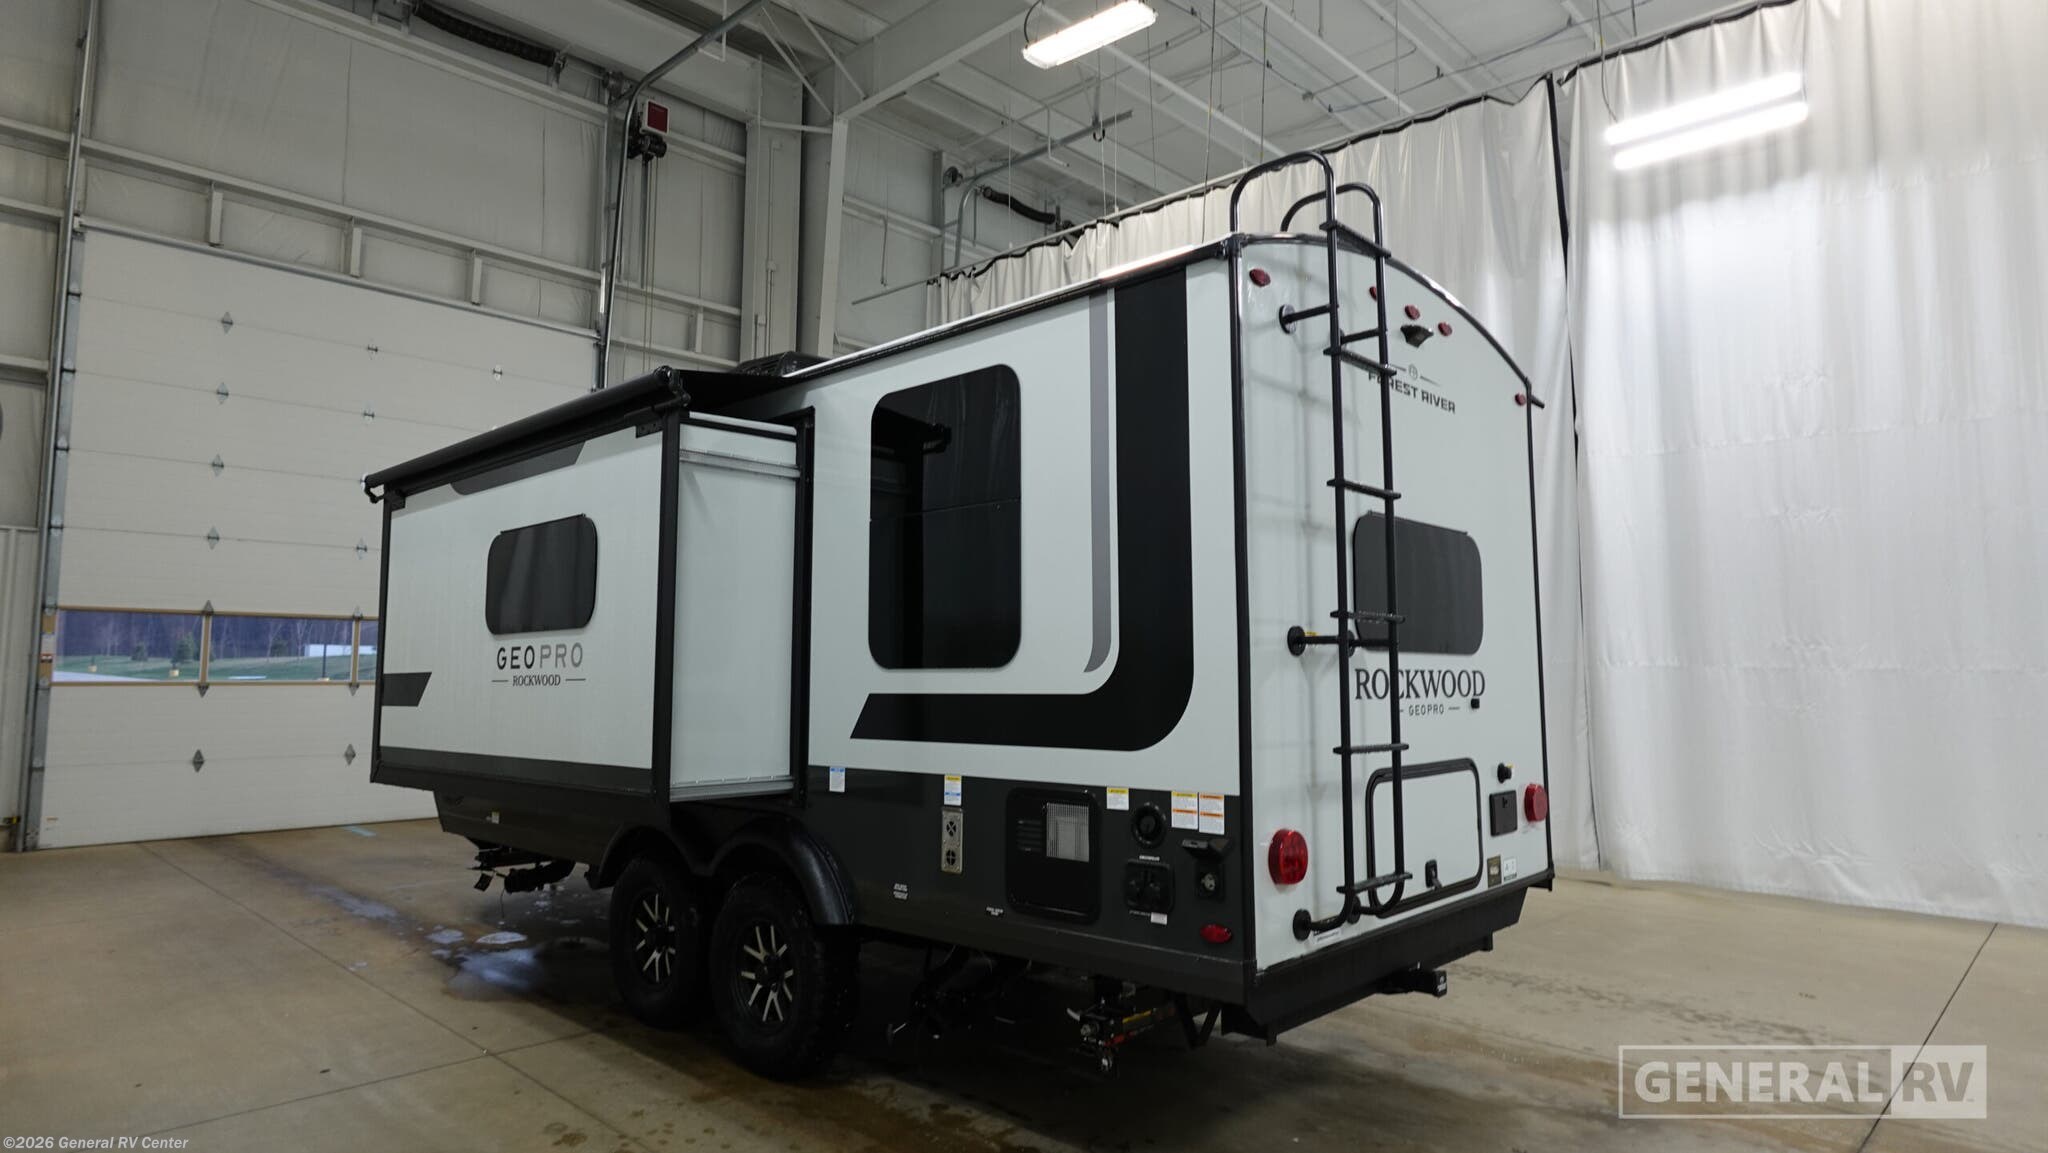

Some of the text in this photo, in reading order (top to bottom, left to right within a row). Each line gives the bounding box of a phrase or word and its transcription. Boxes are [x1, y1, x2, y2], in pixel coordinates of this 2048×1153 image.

[1368, 371, 1456, 414] FREST RIVER
[496, 642, 584, 670] GEOPRO
[512, 674, 561, 687] ROCKWOOD
[1408, 704, 1445, 716] GEOPRO
